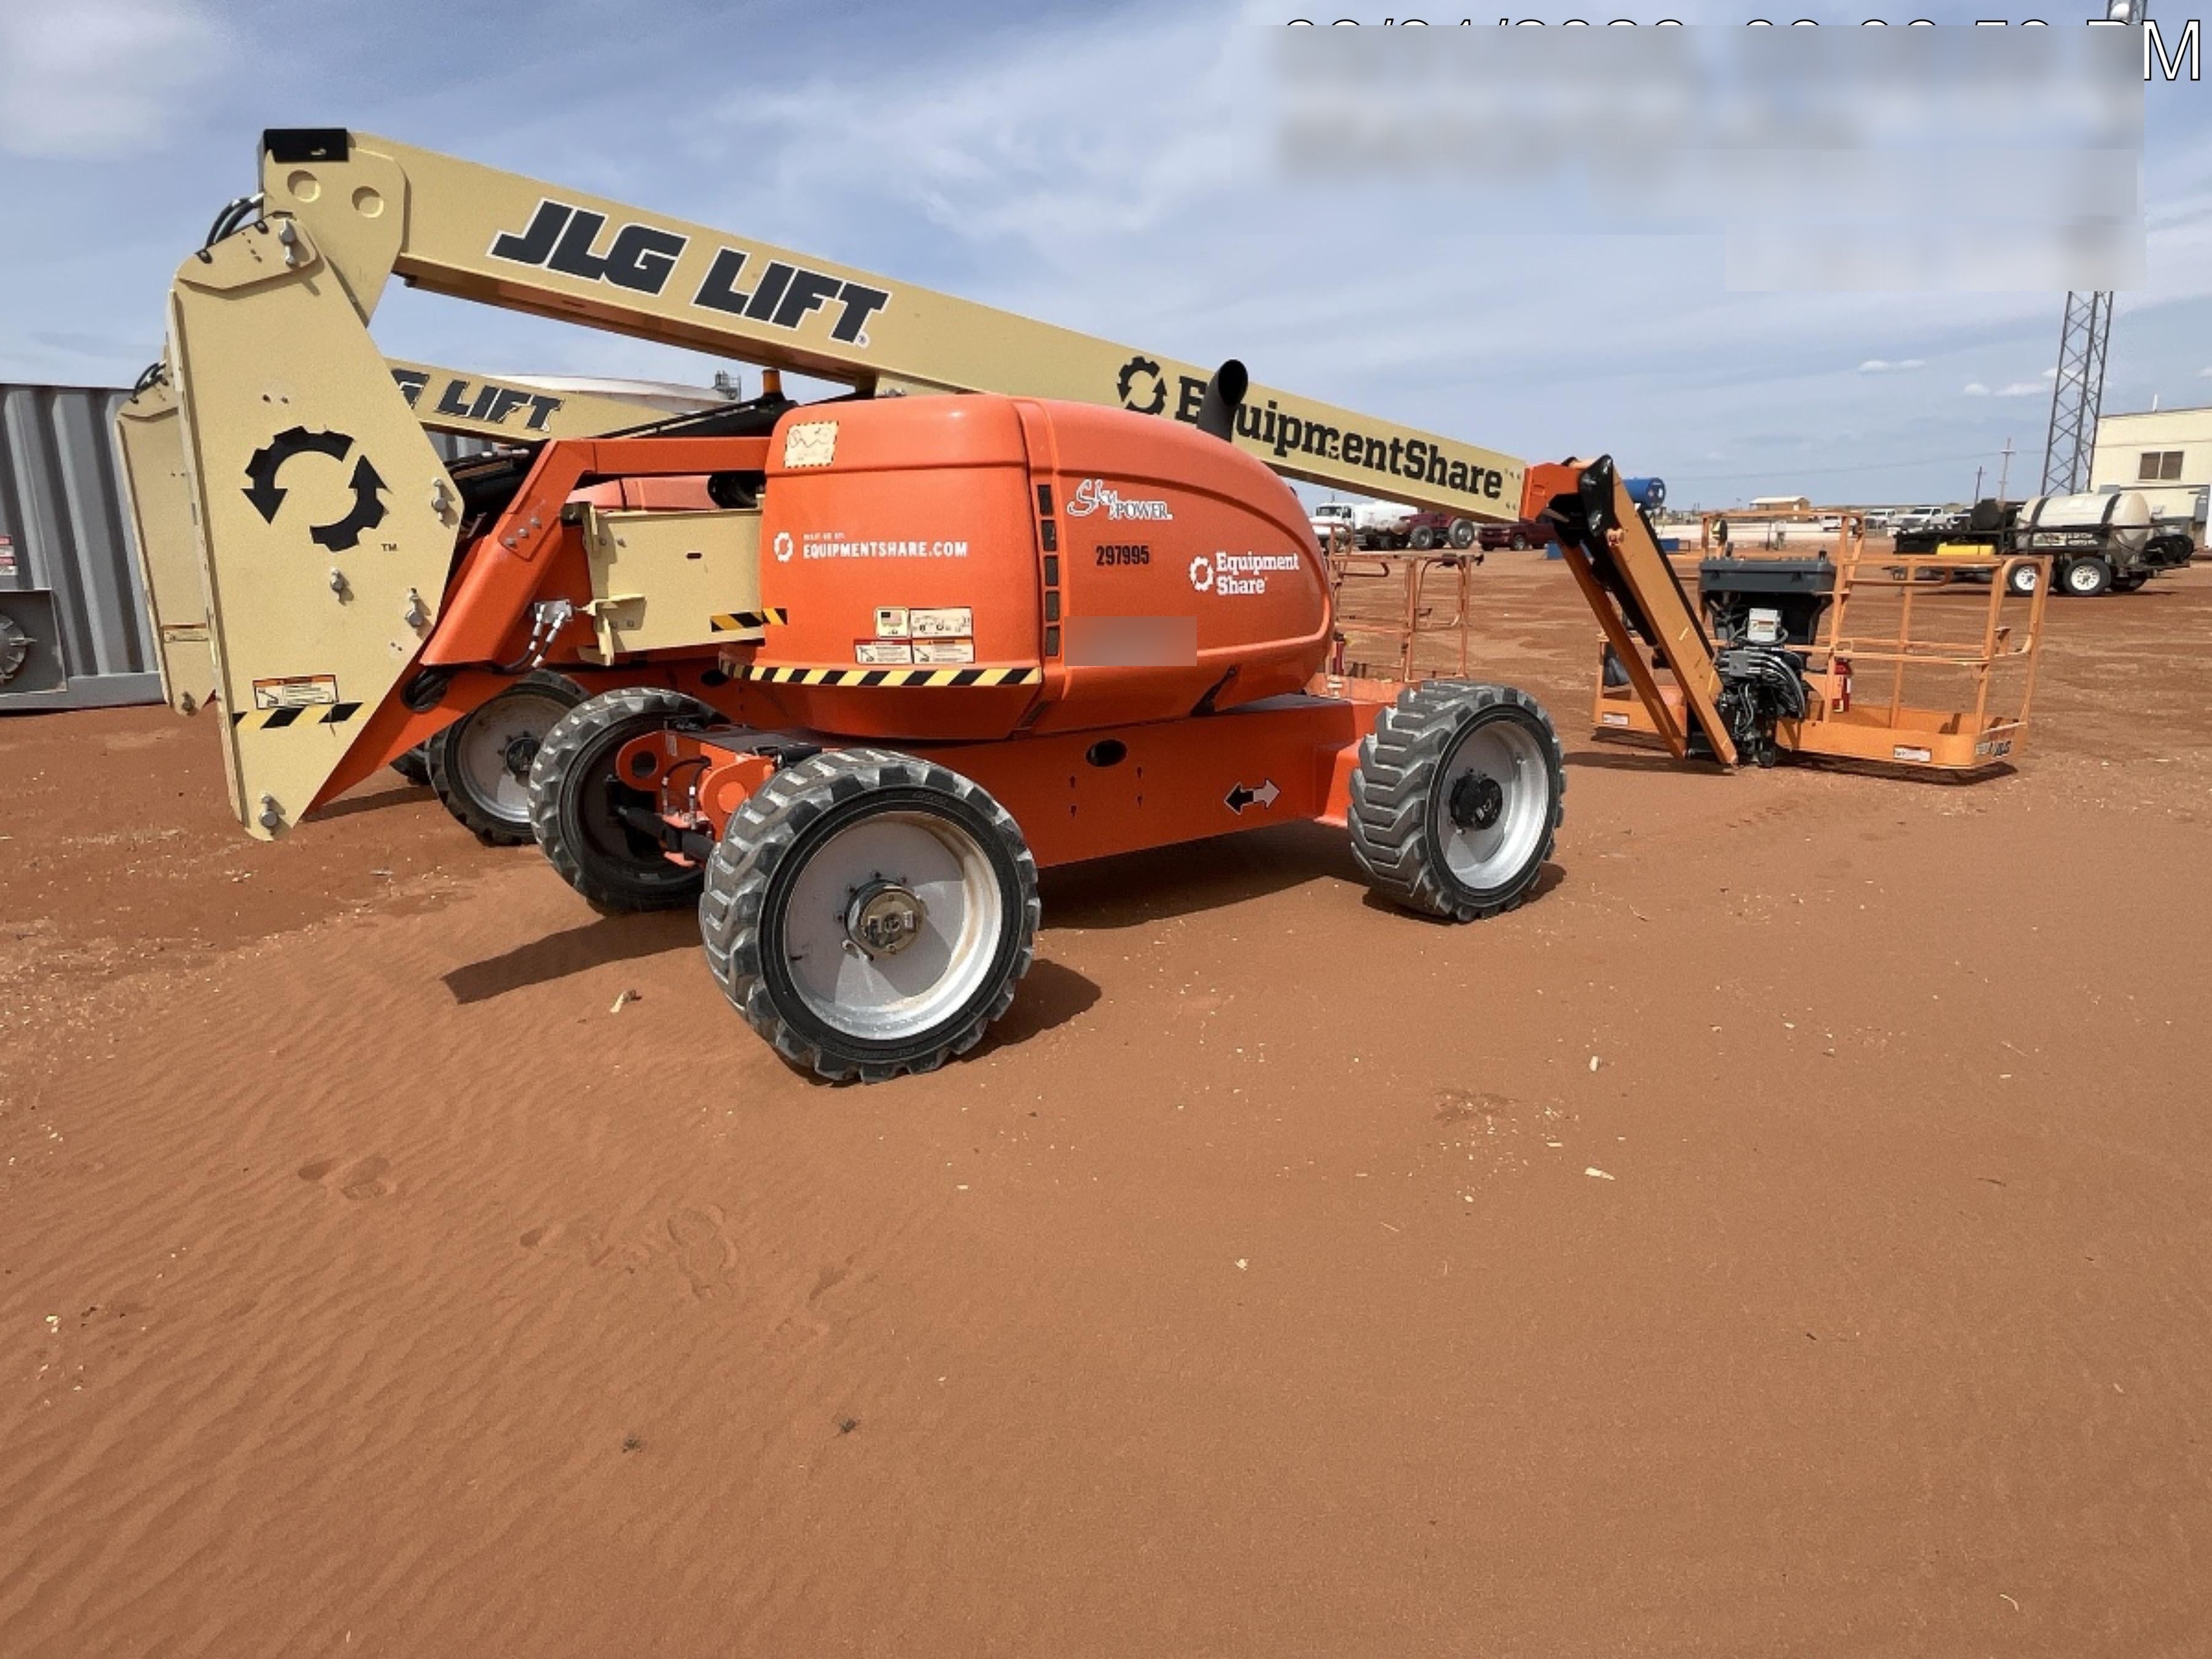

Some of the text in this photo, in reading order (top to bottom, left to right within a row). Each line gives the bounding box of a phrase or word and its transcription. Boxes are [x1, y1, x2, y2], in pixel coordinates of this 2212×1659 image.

[488, 198, 688, 294] JLG
[1175, 375, 1503, 500] EuipmentShare
[803, 541, 968, 559] EQUIPMENTSHARE.COM
[1096, 545, 1150, 567] 297995
[1216, 551, 1300, 576] Equipment
[1217, 576, 1265, 595] Share
